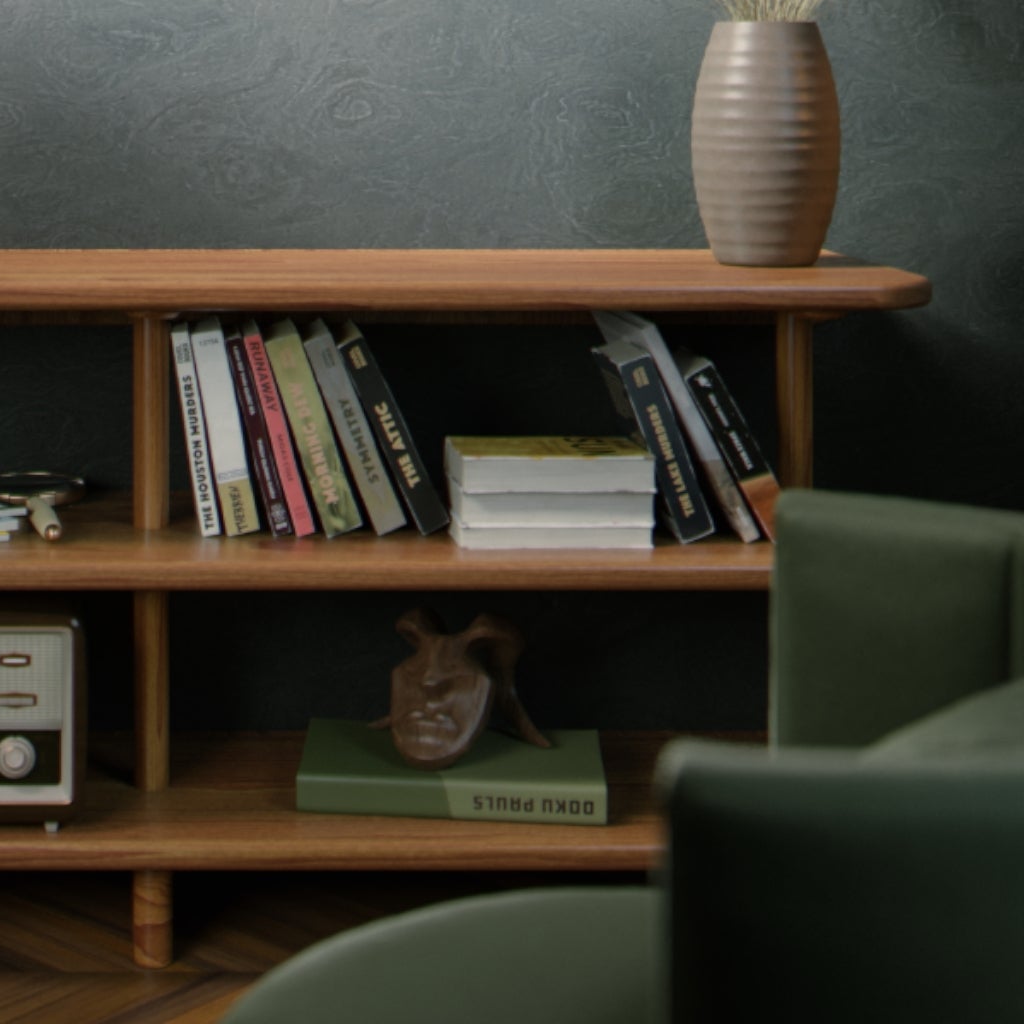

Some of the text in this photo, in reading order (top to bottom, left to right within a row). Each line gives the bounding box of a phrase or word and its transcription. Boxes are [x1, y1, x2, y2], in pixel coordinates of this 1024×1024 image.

[250, 341, 279, 413] RUNAWAY
[183, 375, 216, 531] THE HOUSTON MURDERS
[303, 419, 339, 505] MORNING
[338, 398, 379, 484] SYMMETRY
[374, 401, 421, 489] THE ATTIC
[679, 492, 696, 519] THE
[473, 795, 595, 816] DOKU PAULS
